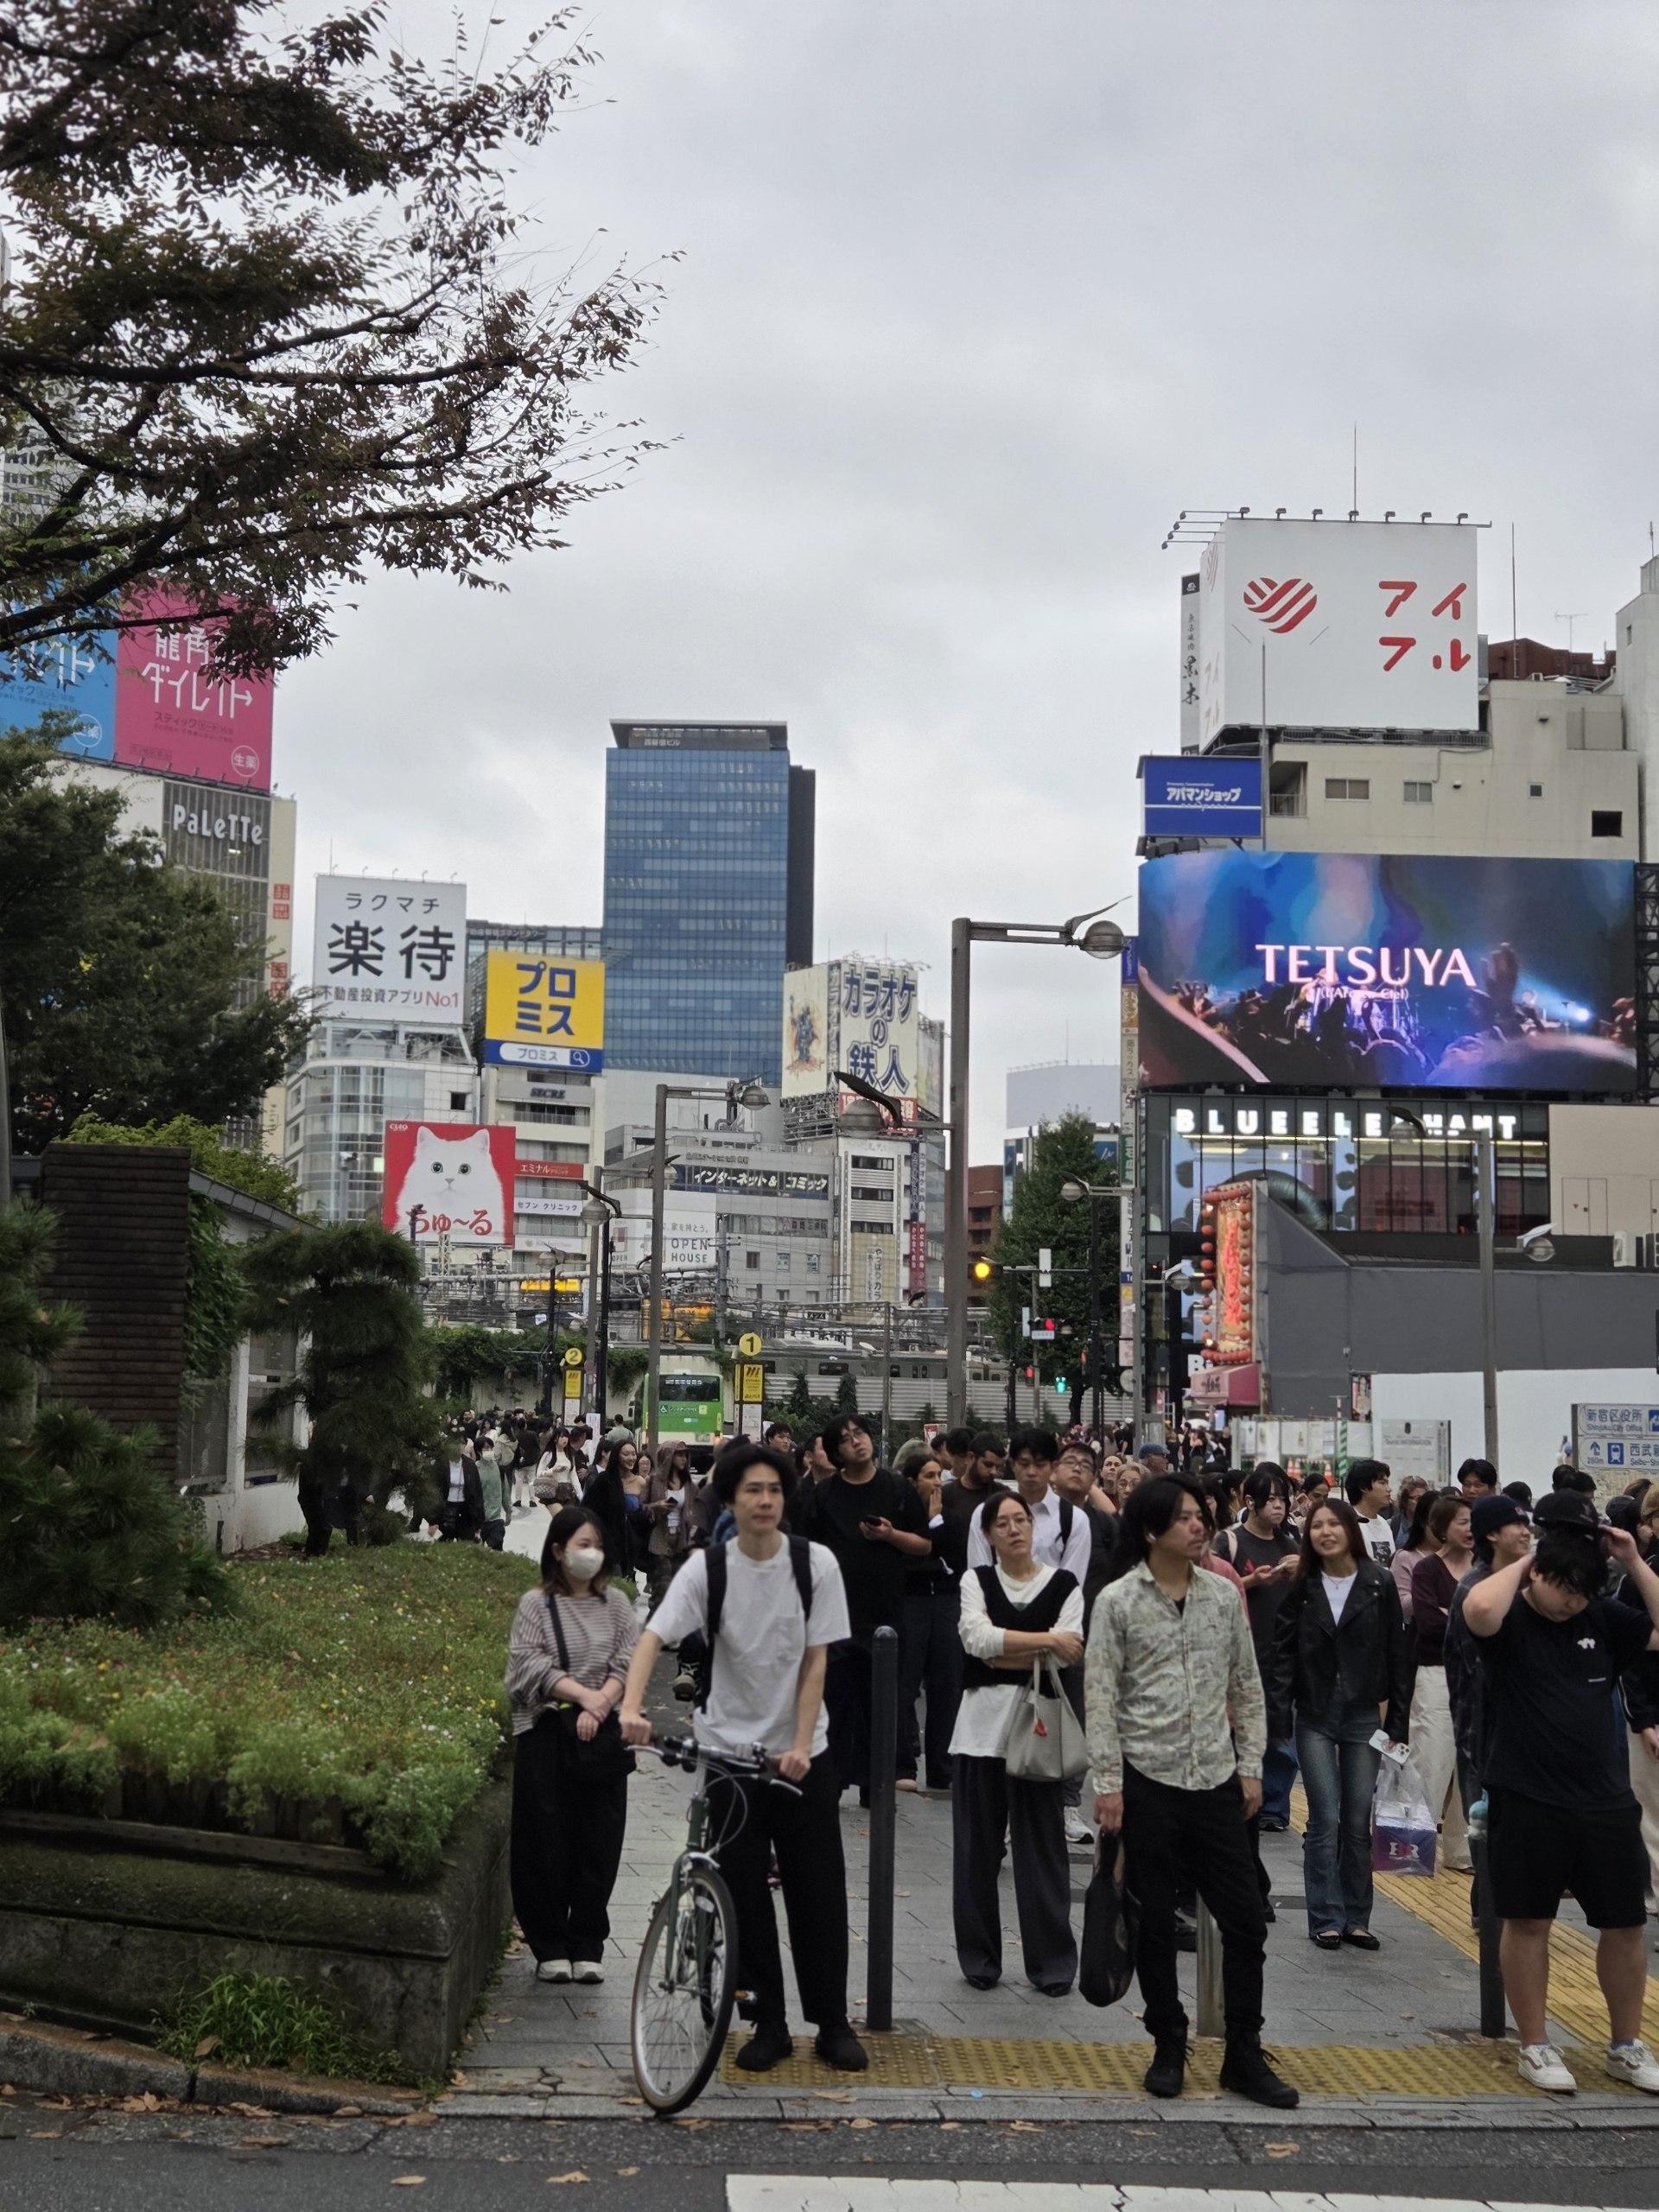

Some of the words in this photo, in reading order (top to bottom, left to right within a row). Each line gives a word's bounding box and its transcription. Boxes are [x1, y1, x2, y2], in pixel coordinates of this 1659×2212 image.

[1378, 581, 1468, 620] アイ
[1378, 636, 1471, 671] フル
[1166, 786, 1242, 802] アパマンショップ
[346, 892, 440, 914] ラクマチ
[327, 919, 455, 982] 楽待
[1255, 943, 1476, 987] TETSUYA
[516, 960, 576, 1000] プロ
[842, 963, 917, 1024] カラオケ
[515, 1001, 575, 1036] ミス
[870, 1014, 888, 1048] の
[518, 1047, 558, 1062] プロミス
[847, 1039, 909, 1095] 鉄人
[785, 1175, 828, 1191] コミック
[671, 1237, 708, 1250] OPEN
[671, 1252, 708, 1263] HOUSE
[569, 1350, 579, 1363] 2
[746, 1336, 754, 1353] 1
[1586, 1408, 1643, 1423] 新宿区役所
